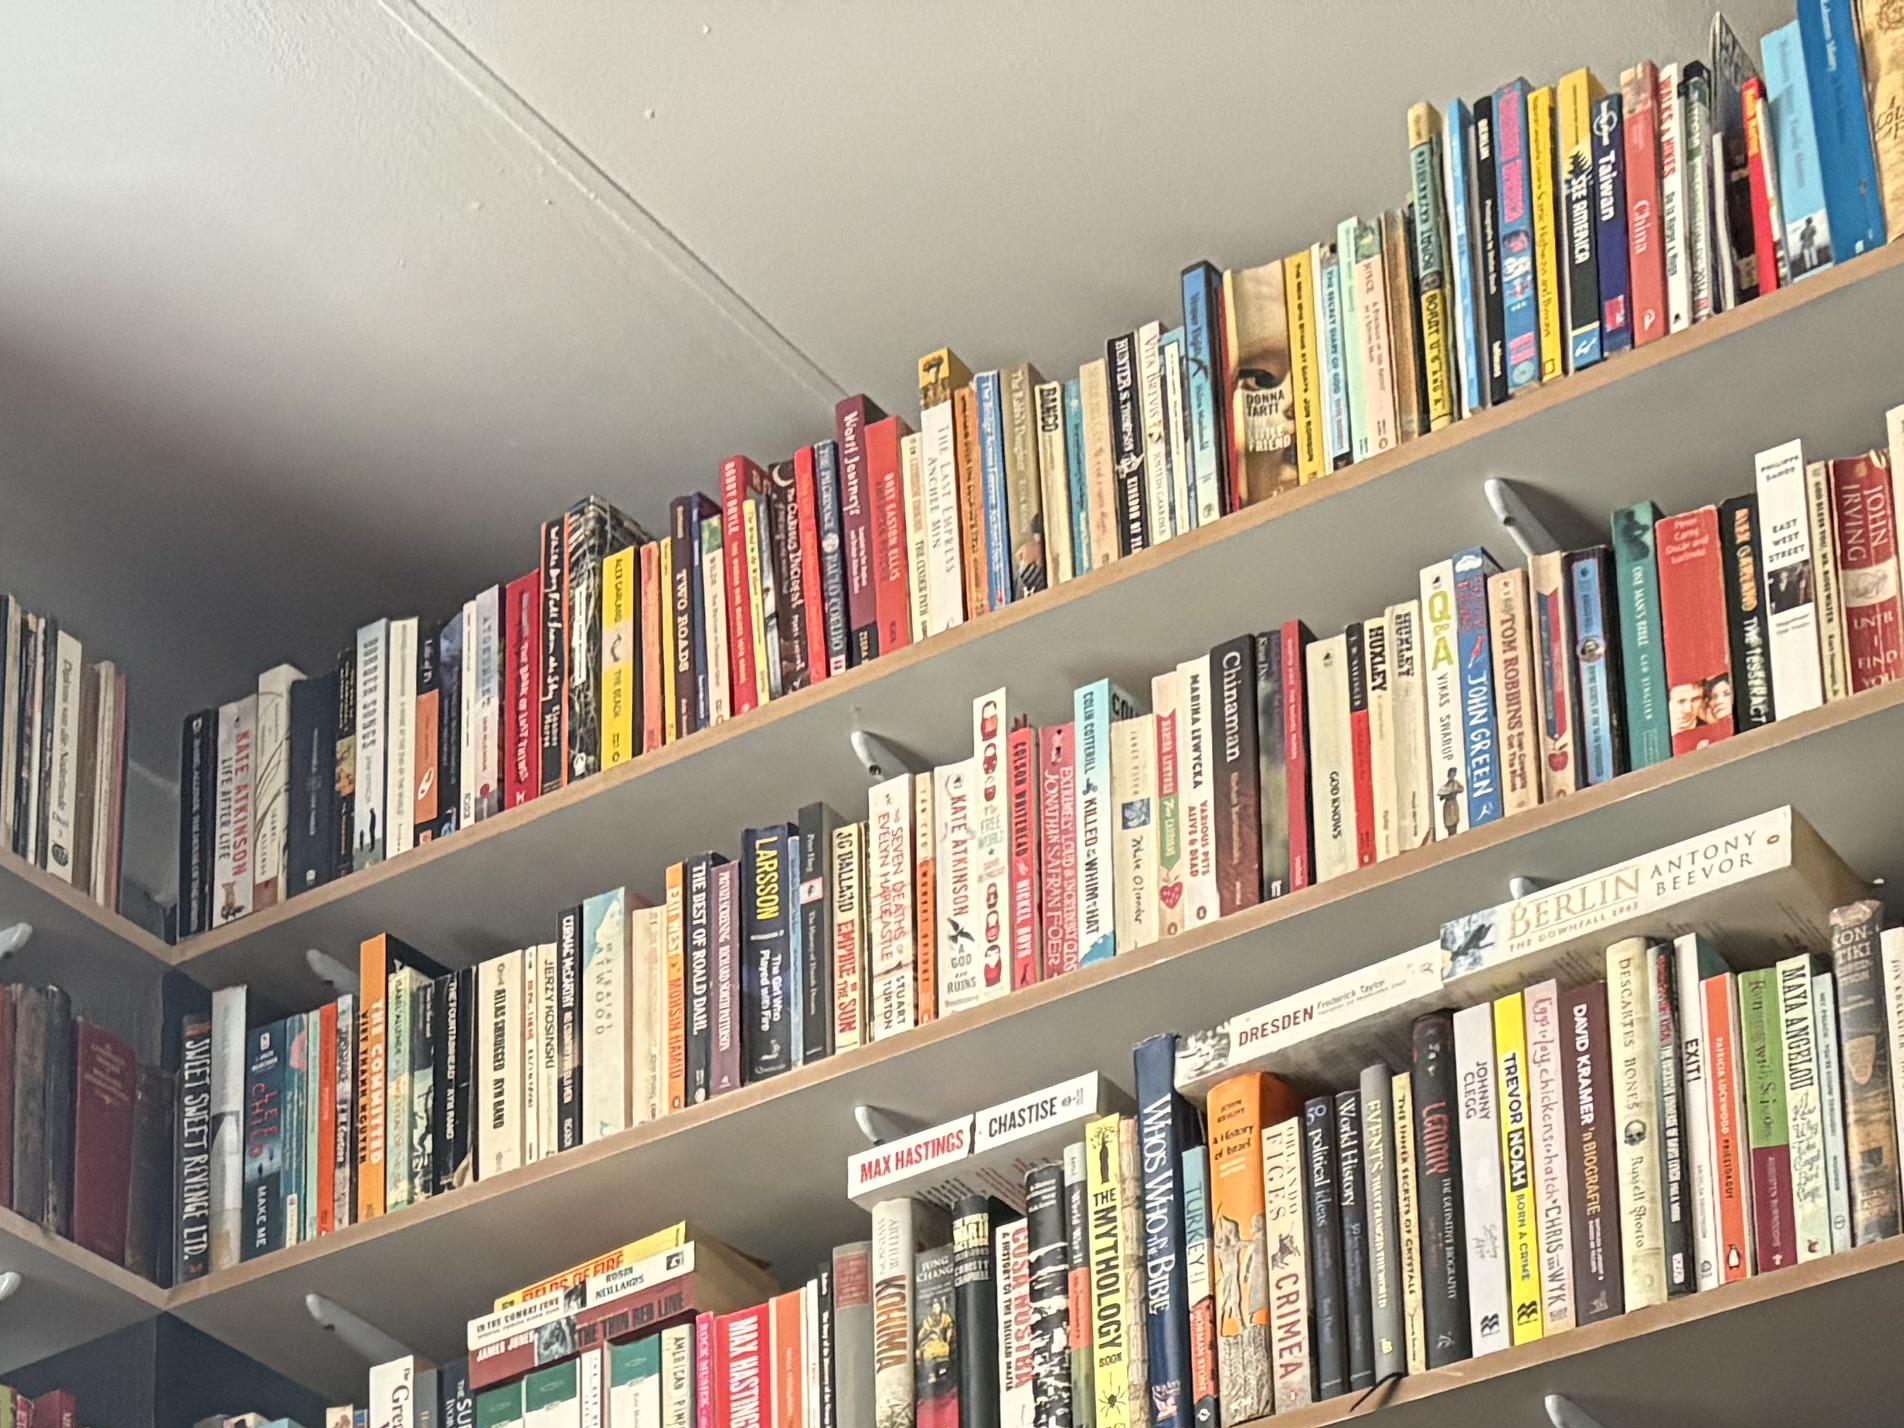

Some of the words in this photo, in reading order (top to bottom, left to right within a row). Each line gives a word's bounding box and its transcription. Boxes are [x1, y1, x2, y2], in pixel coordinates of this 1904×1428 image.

[1596, 149, 1617, 223] Taiwan
[1772, 519, 1797, 534] EAST
[1774, 530, 1802, 547] WEST
[1842, 487, 1868, 563] IRVING
[1861, 484, 1886, 551] JOHN
[1767, 545, 1804, 564] STREET
[1221, 650, 1241, 763] Chinaman
[754, 835, 778, 923] LARSSON
[1650, 830, 1756, 879] ANTONY
[1655, 854, 1753, 897] BEEVOR
[1508, 865, 1641, 940] BERLIN
[1238, 1005, 1314, 1047] DRESDEN
[988, 1096, 1058, 1138] CHASTISE
[1502, 1052, 1524, 1125] TREVOR
[859, 1156, 891, 1184] MAX
[894, 1130, 965, 1174] HASTINGS
[1508, 1130, 1526, 1190] NOAH
[1092, 1187, 1117, 1204] THE
[1092, 1203, 1124, 1353] MYTHOLOGY
[1274, 1272, 1304, 1381] CRIMEA
